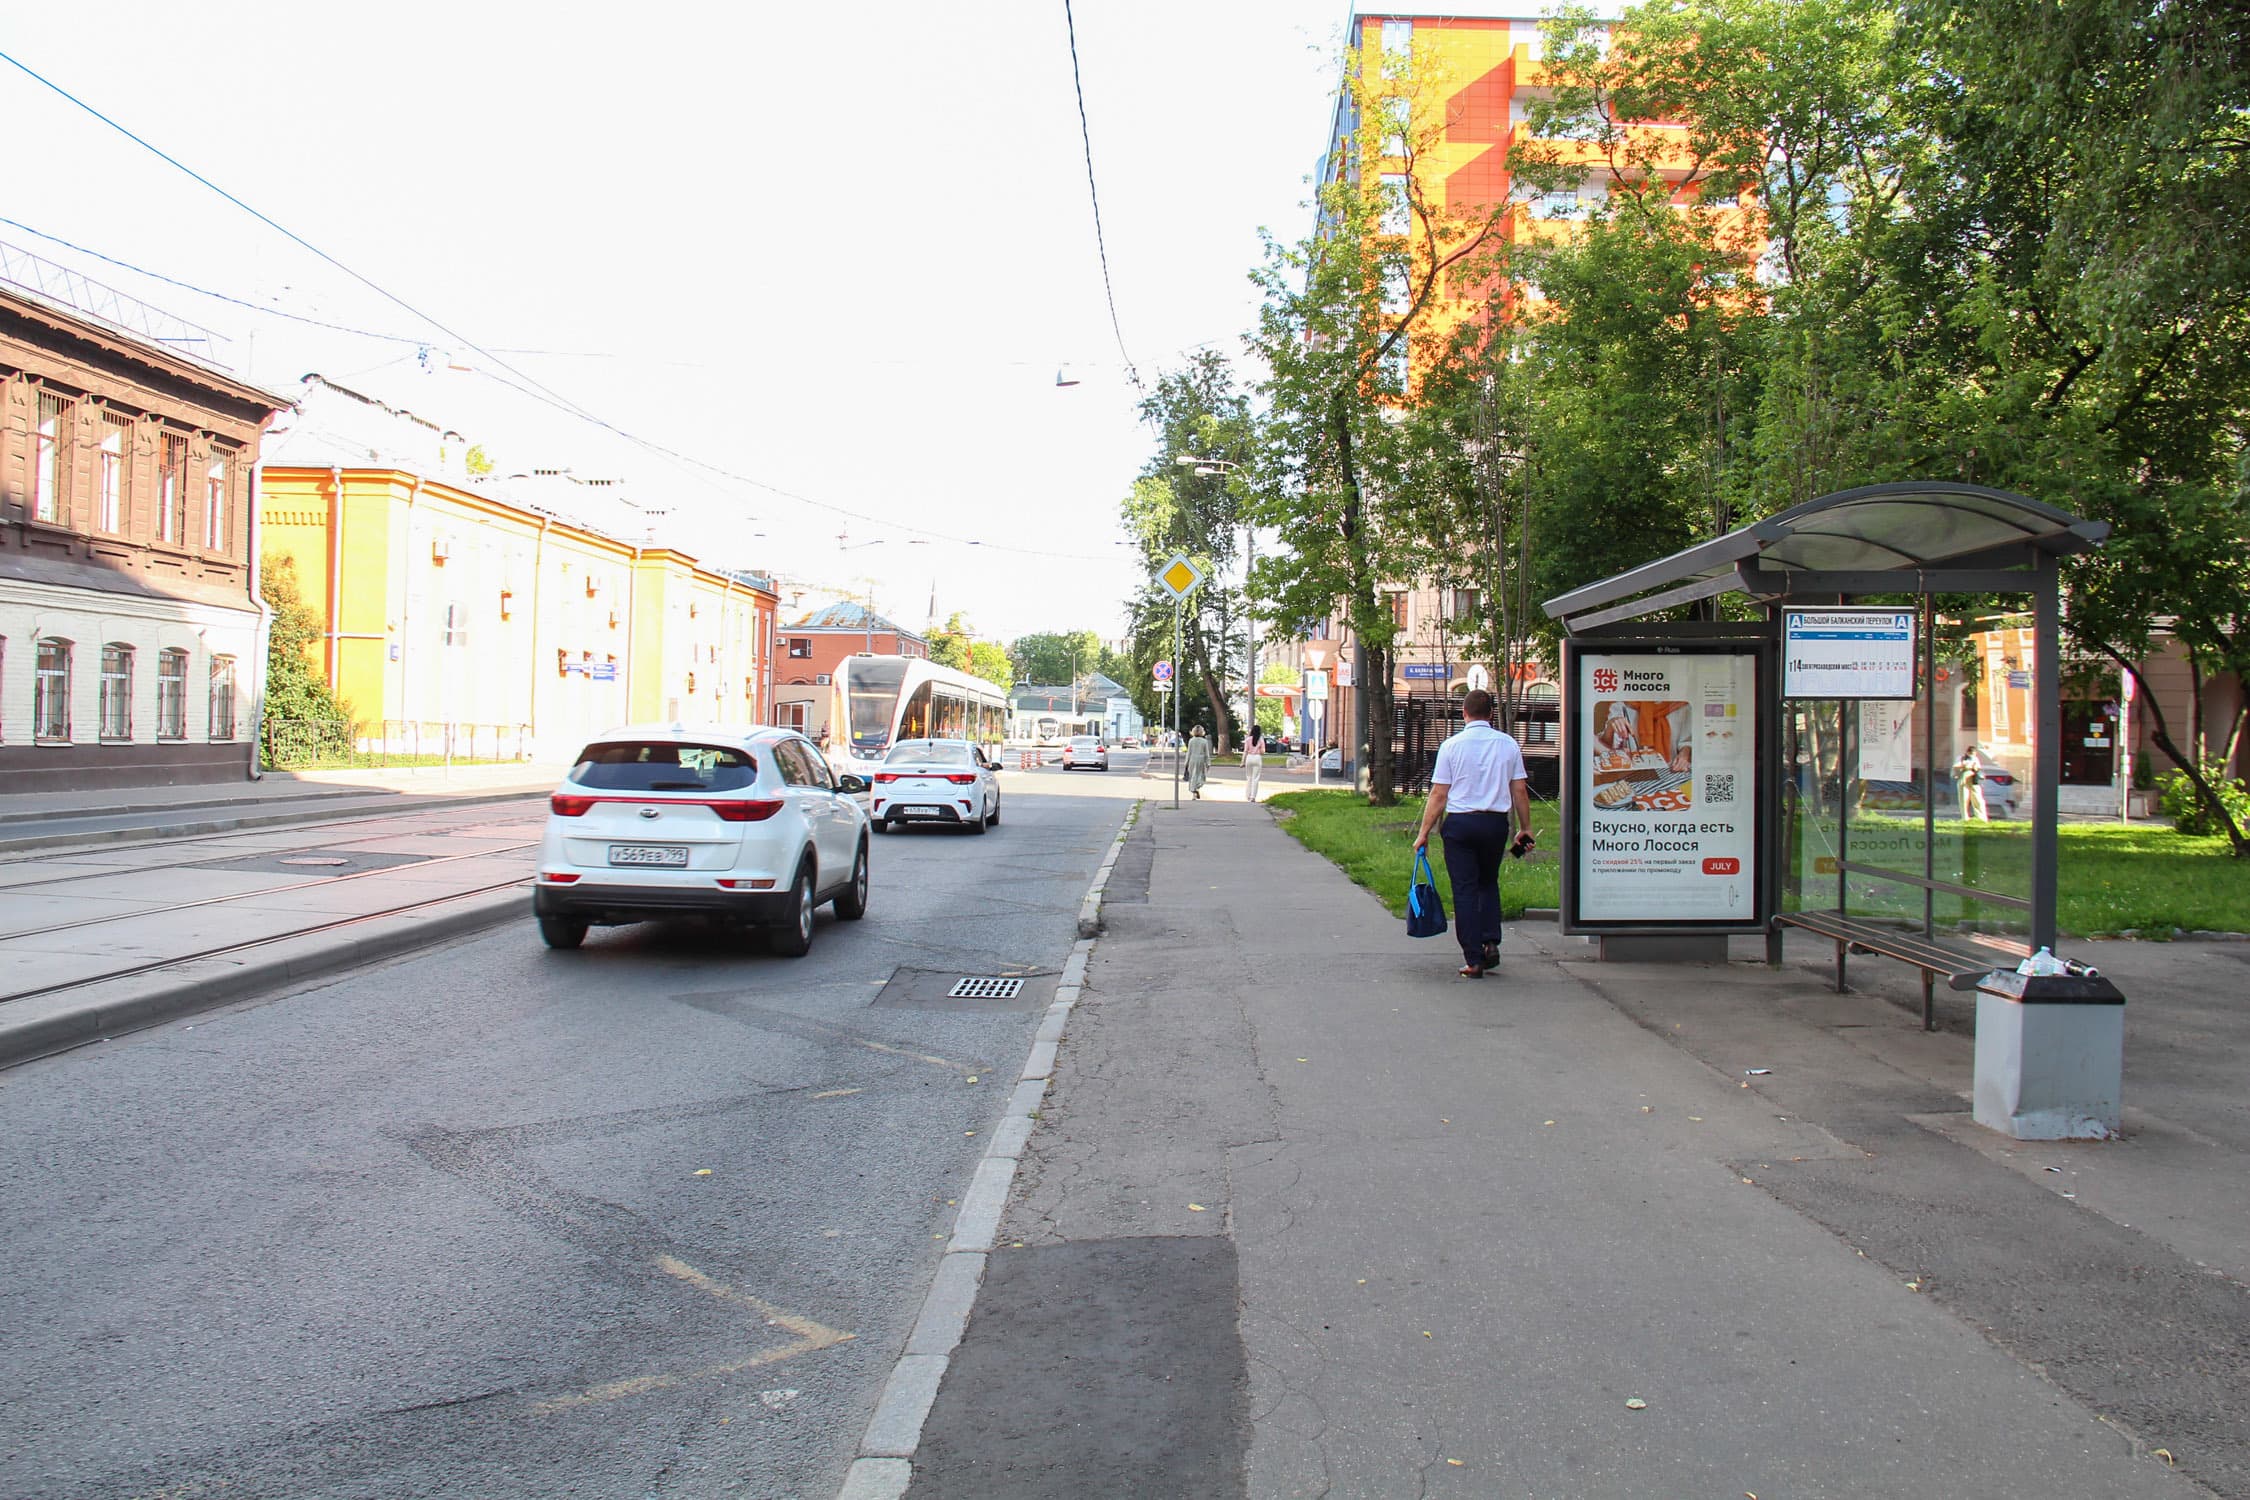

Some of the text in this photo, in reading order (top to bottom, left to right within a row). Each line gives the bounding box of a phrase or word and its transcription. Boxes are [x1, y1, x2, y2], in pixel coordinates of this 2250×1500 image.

[1803, 616, 1829, 625] БОЛЬШОЙ
[1830, 616, 1865, 625] БАЛКАНСКИЙ
[1866, 617, 1892, 625] ПЕРЕУЛОК
[1623, 670, 1664, 680] Много
[1623, 682, 1670, 692] лосося
[1592, 821, 1735, 836] Вкусно, когда есть
[1592, 839, 1699, 851] Много Лосося
[1602, 858, 1629, 866] скидкой
[1653, 859, 1677, 867] первый
[1710, 862, 1732, 870] JULY
